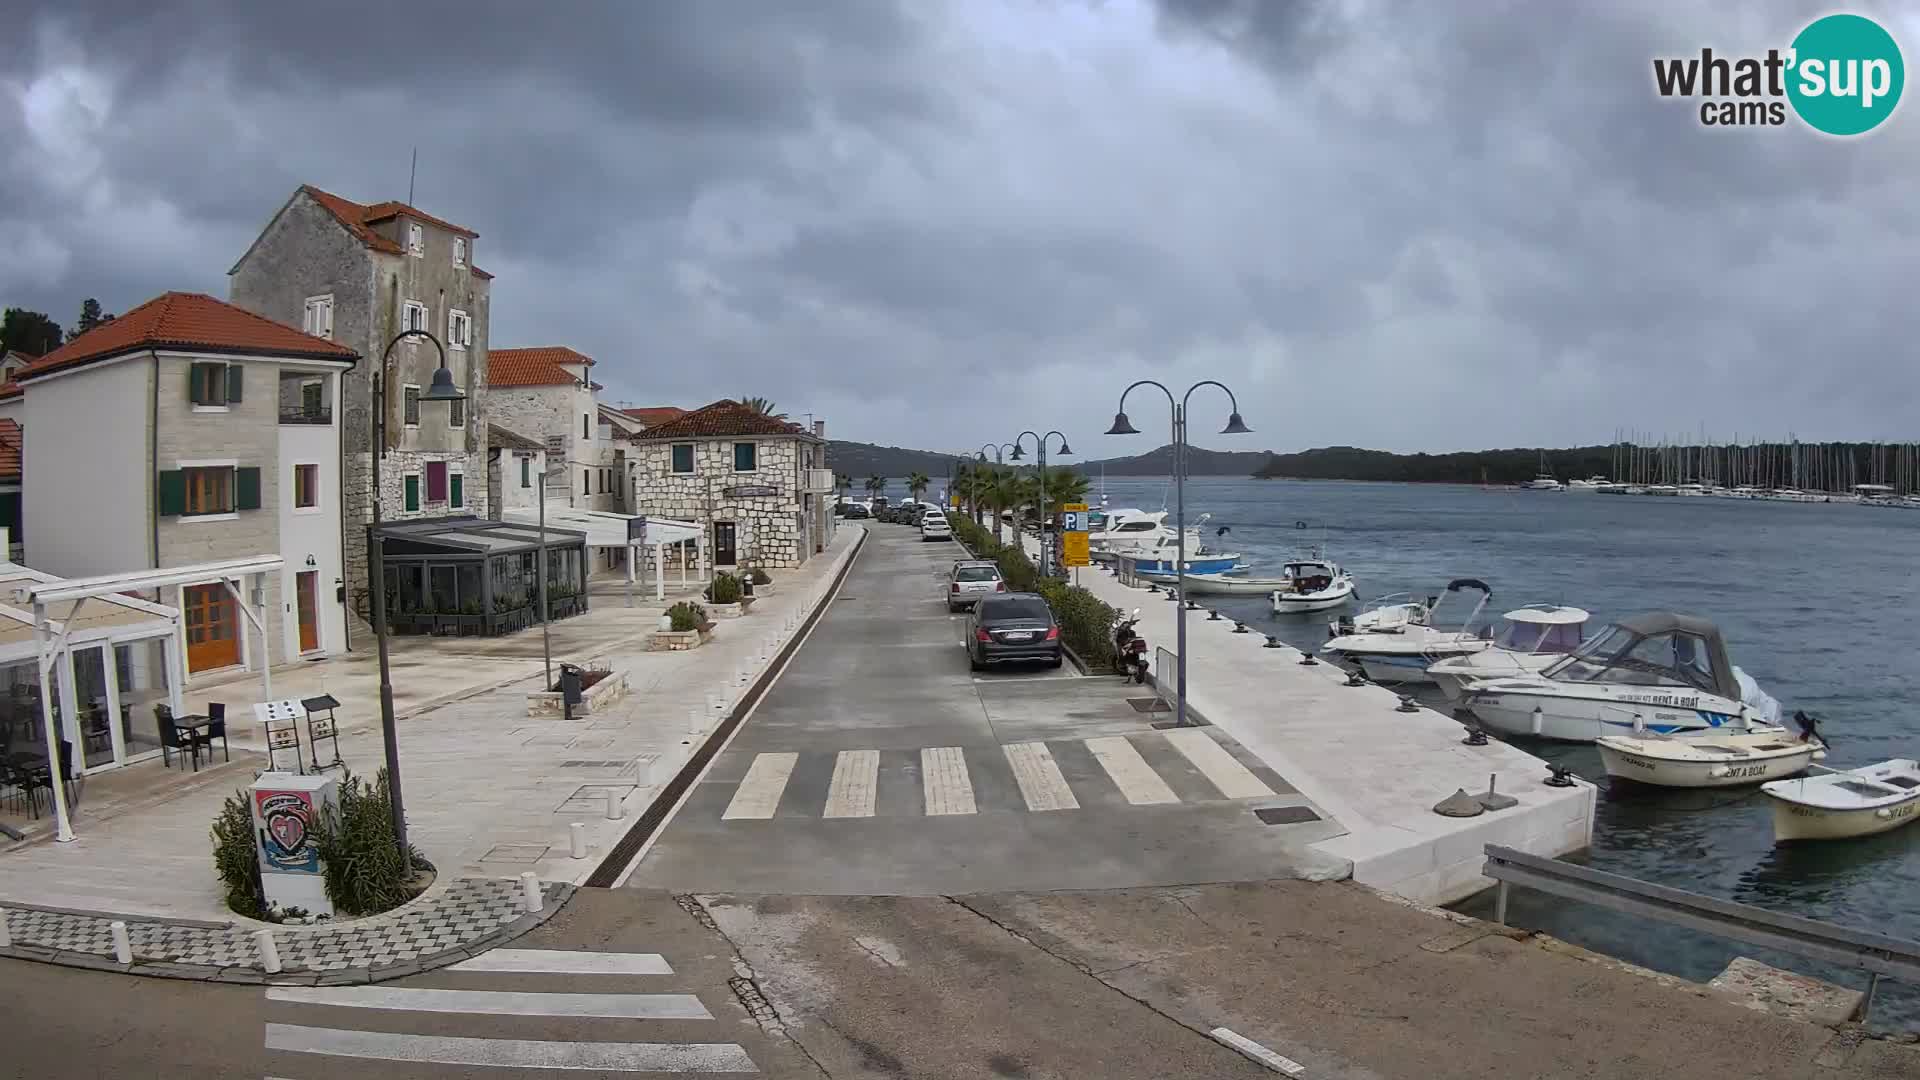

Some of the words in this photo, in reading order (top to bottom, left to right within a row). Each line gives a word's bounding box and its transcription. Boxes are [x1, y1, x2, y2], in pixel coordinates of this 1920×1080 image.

[1652, 696, 1673, 704] RENT
[1680, 697, 1699, 708] BOAT
[1742, 767, 1747, 777] A
[1749, 764, 1767, 777] BOAT
